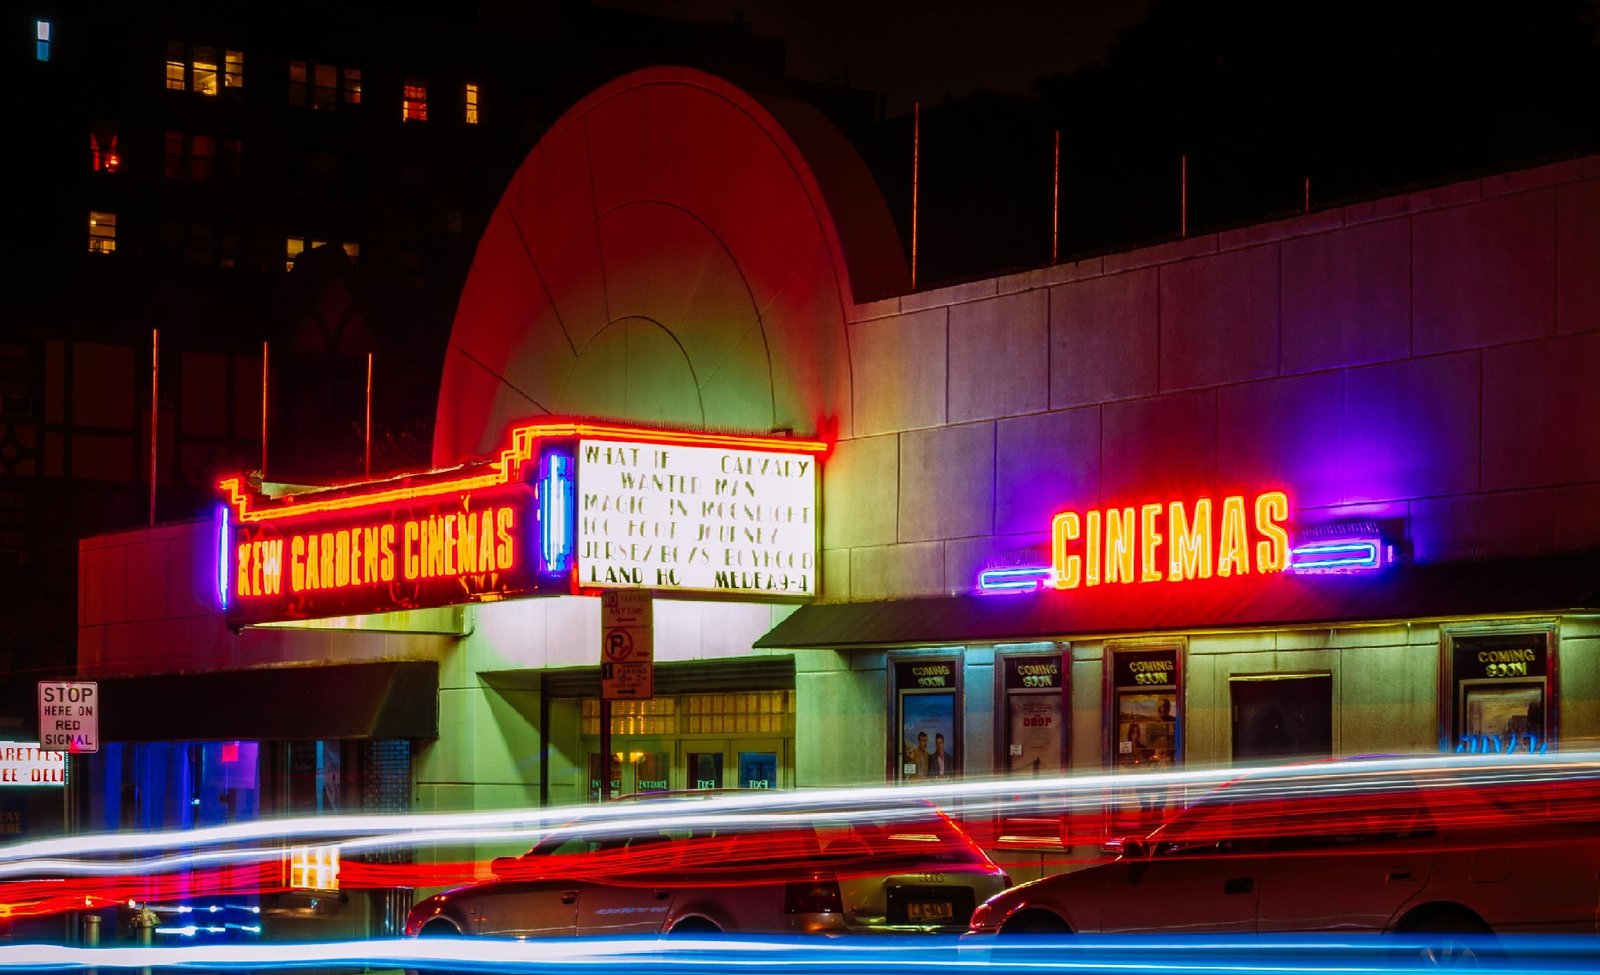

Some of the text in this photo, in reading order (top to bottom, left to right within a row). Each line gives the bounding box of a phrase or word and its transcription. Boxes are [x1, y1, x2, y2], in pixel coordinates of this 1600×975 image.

[584, 445, 670, 469] WHAT IF
[721, 455, 809, 478] CALVARY
[621, 471, 756, 497] WANTED MAN
[584, 494, 648, 514] MAGIC
[669, 498, 688, 517] IN
[1051, 491, 1290, 590] CINEMAS
[237, 507, 514, 597] KEW GARDENS CINEMAS
[591, 565, 644, 586] LAND
[656, 568, 682, 586] HO
[1478, 649, 1536, 663] COMING
[912, 665, 950, 677] COMING
[1017, 664, 1058, 676] COMING
[1129, 660, 1174, 673] COMING
[1485, 662, 1528, 678] SOON
[918, 676, 945, 688] SOON
[1022, 675, 1053, 688] SOON
[1135, 673, 1168, 685] SOON
[44, 687, 93, 703] STOP
[44, 706, 93, 716] HERE ON
[55, 720, 81, 730] RED
[1023, 717, 1052, 727] DROP
[45, 734, 92, 746] SIGNAL
[31, 768, 64, 782] DELI
[639, 779, 668, 789] ENTRANCE
